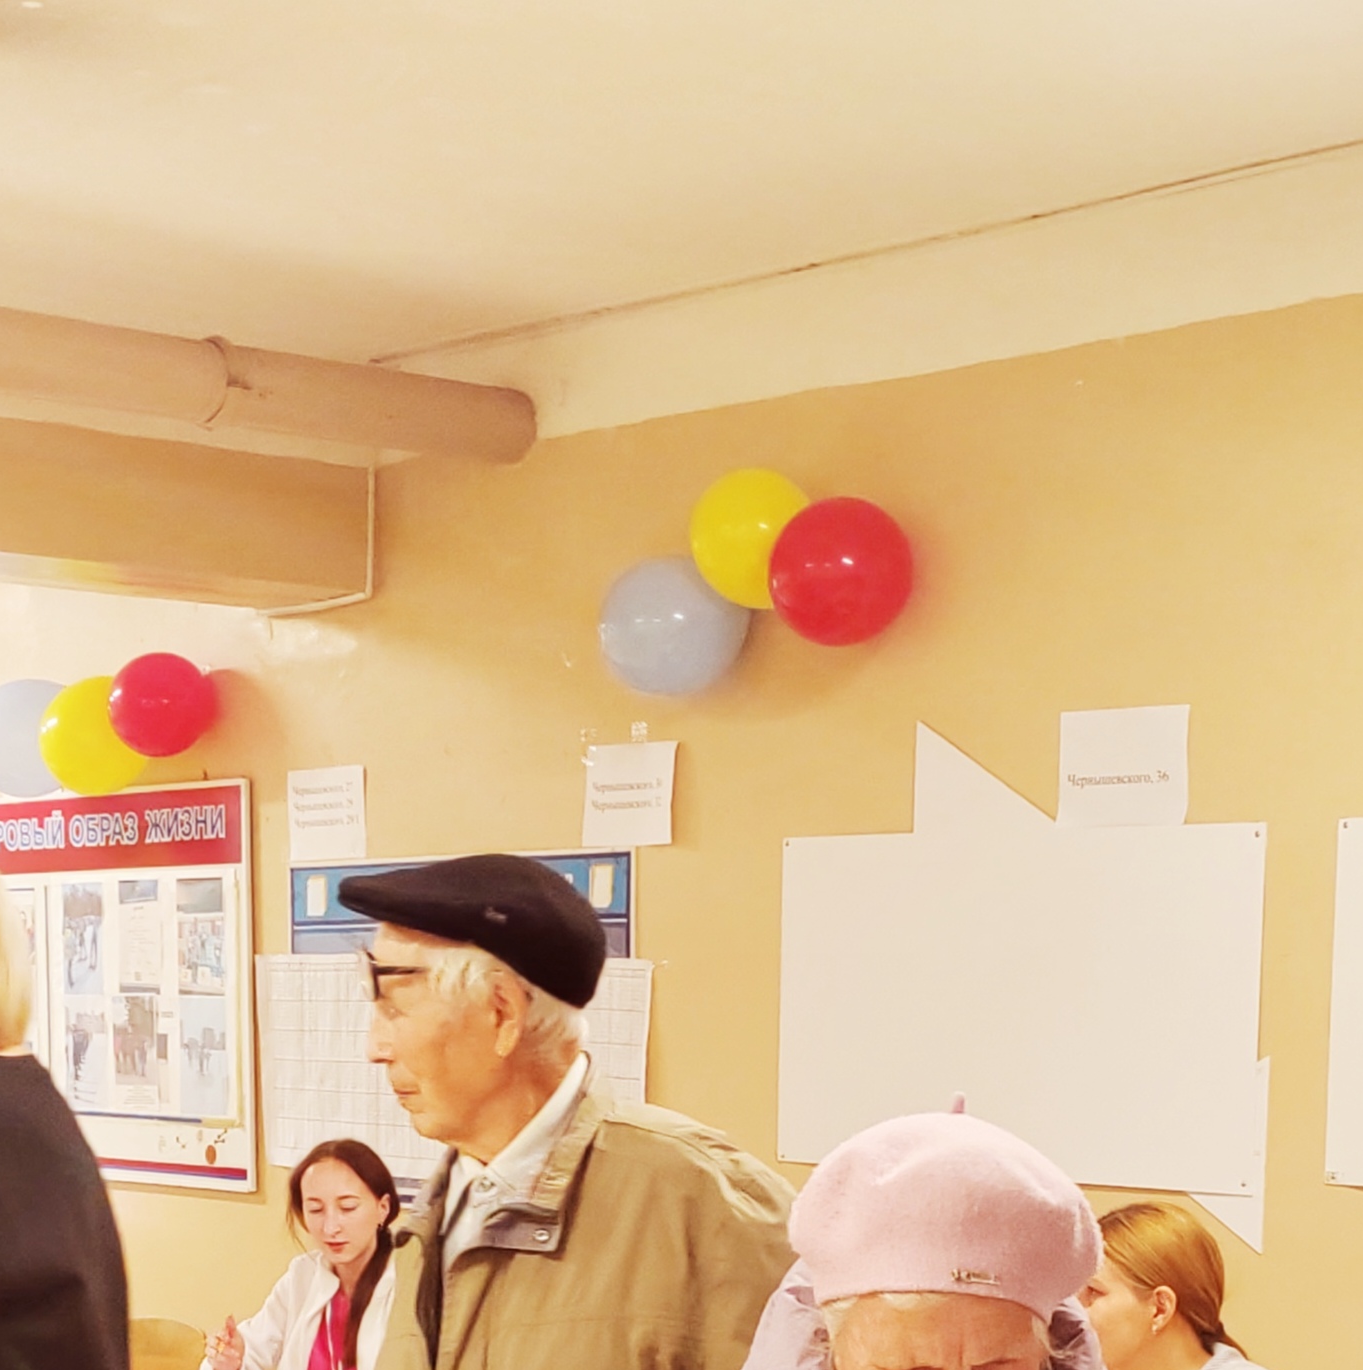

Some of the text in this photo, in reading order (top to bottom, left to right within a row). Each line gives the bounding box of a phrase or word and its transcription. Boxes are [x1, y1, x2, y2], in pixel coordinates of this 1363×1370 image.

[1156, 769, 1170, 783] 36
[69, 812, 139, 848] ОБРАЗ
[145, 804, 226, 843] ЖИЗНИ
